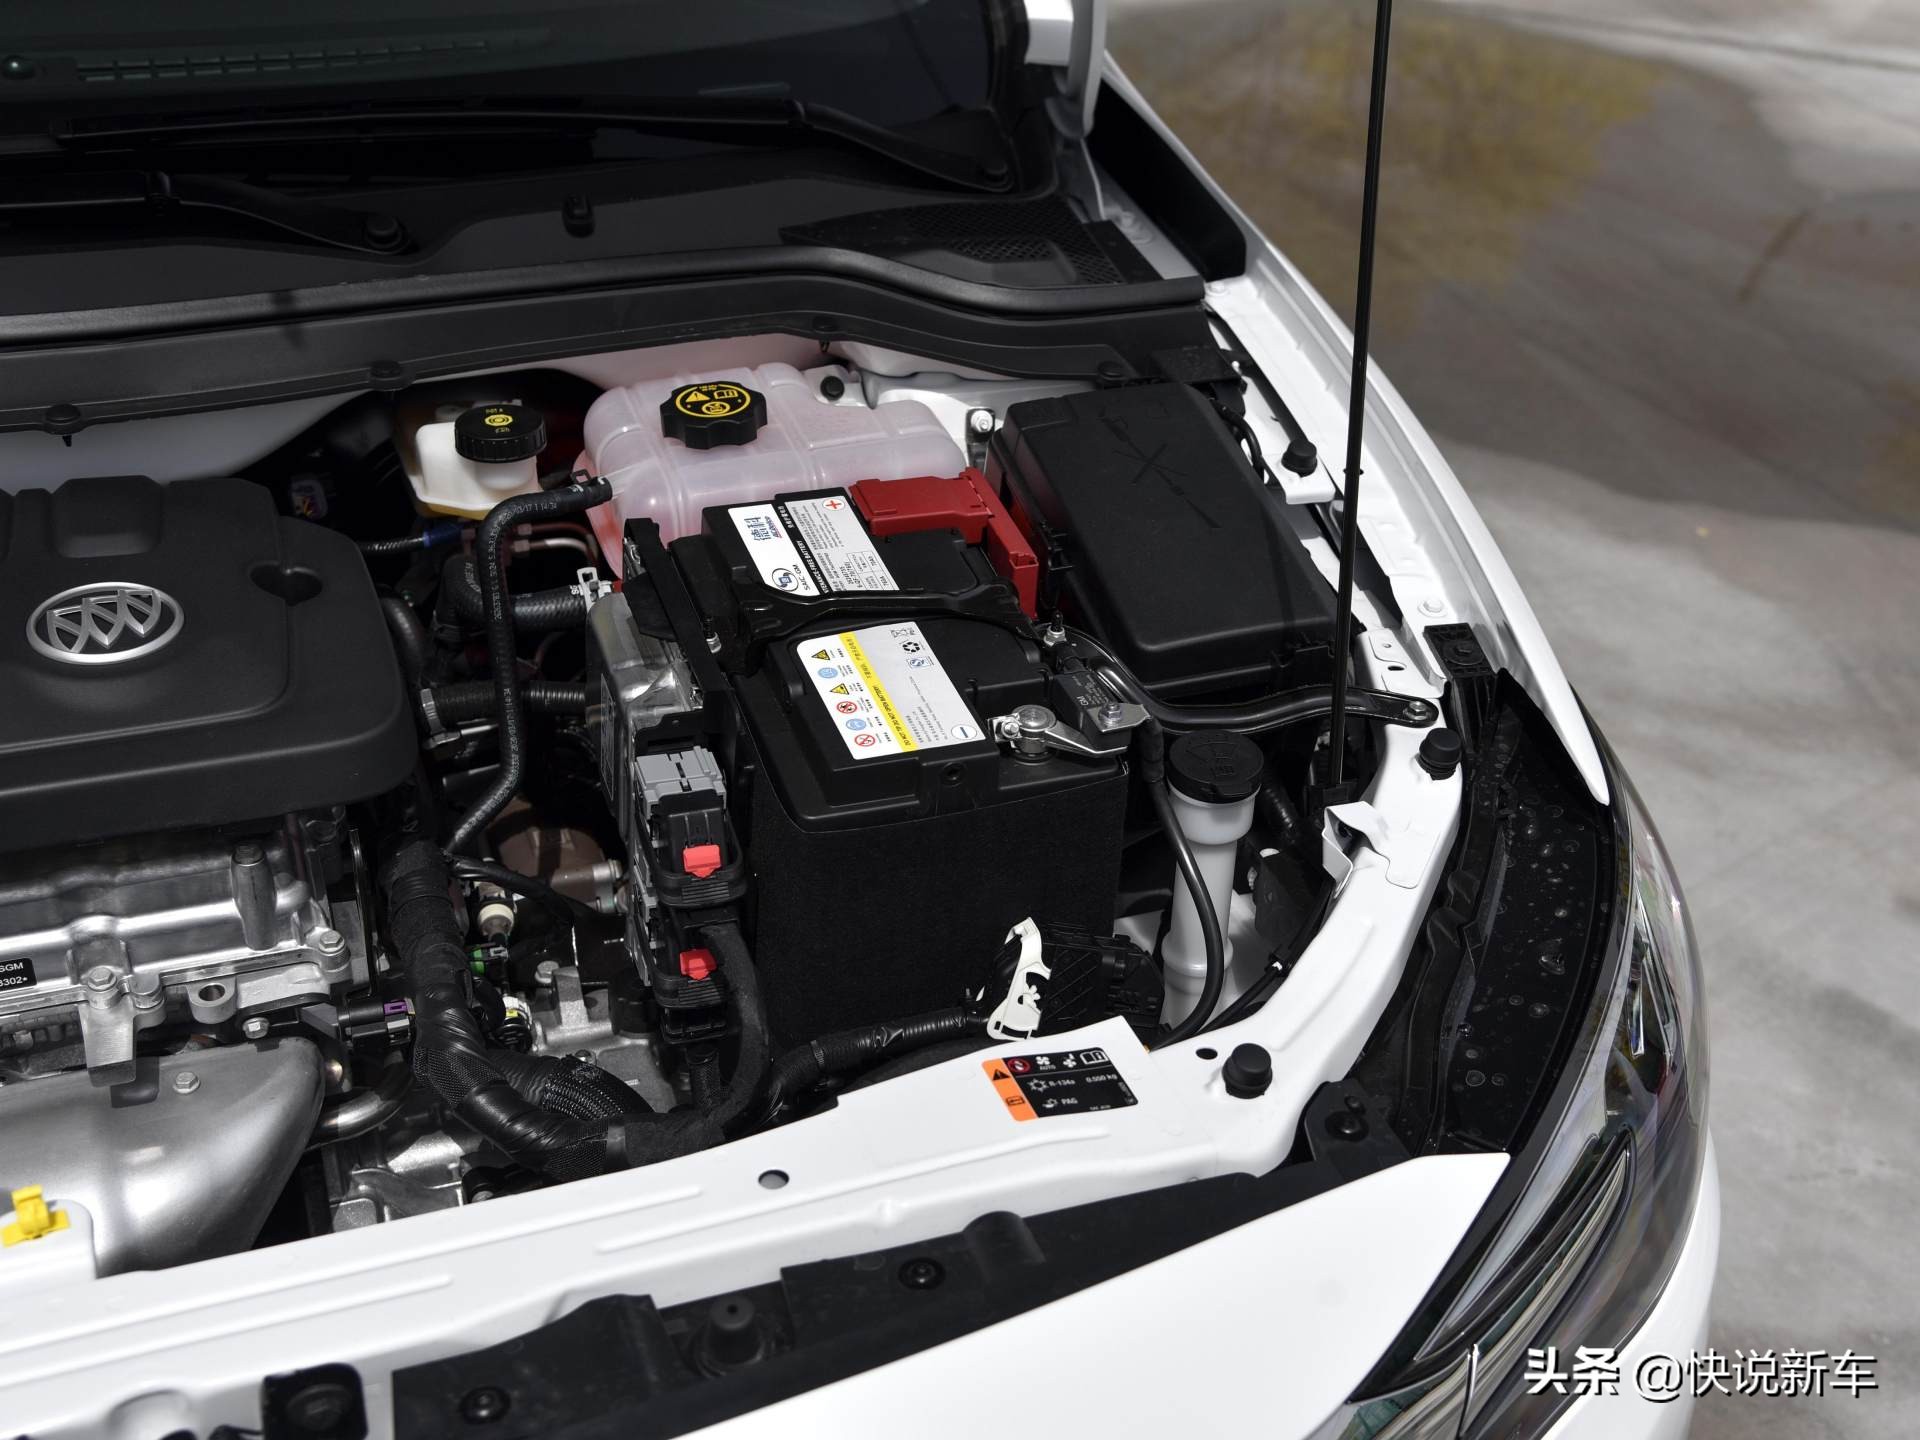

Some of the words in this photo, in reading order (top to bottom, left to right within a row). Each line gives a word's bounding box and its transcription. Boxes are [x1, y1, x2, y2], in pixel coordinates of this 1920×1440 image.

[742, 516, 772, 540] 德科
[0, 962, 24, 973] SGM
[1048, 1078, 1076, 1087] R-134a
[1107, 1073, 1118, 1081] kg
[1061, 1097, 1079, 1105] PAG
